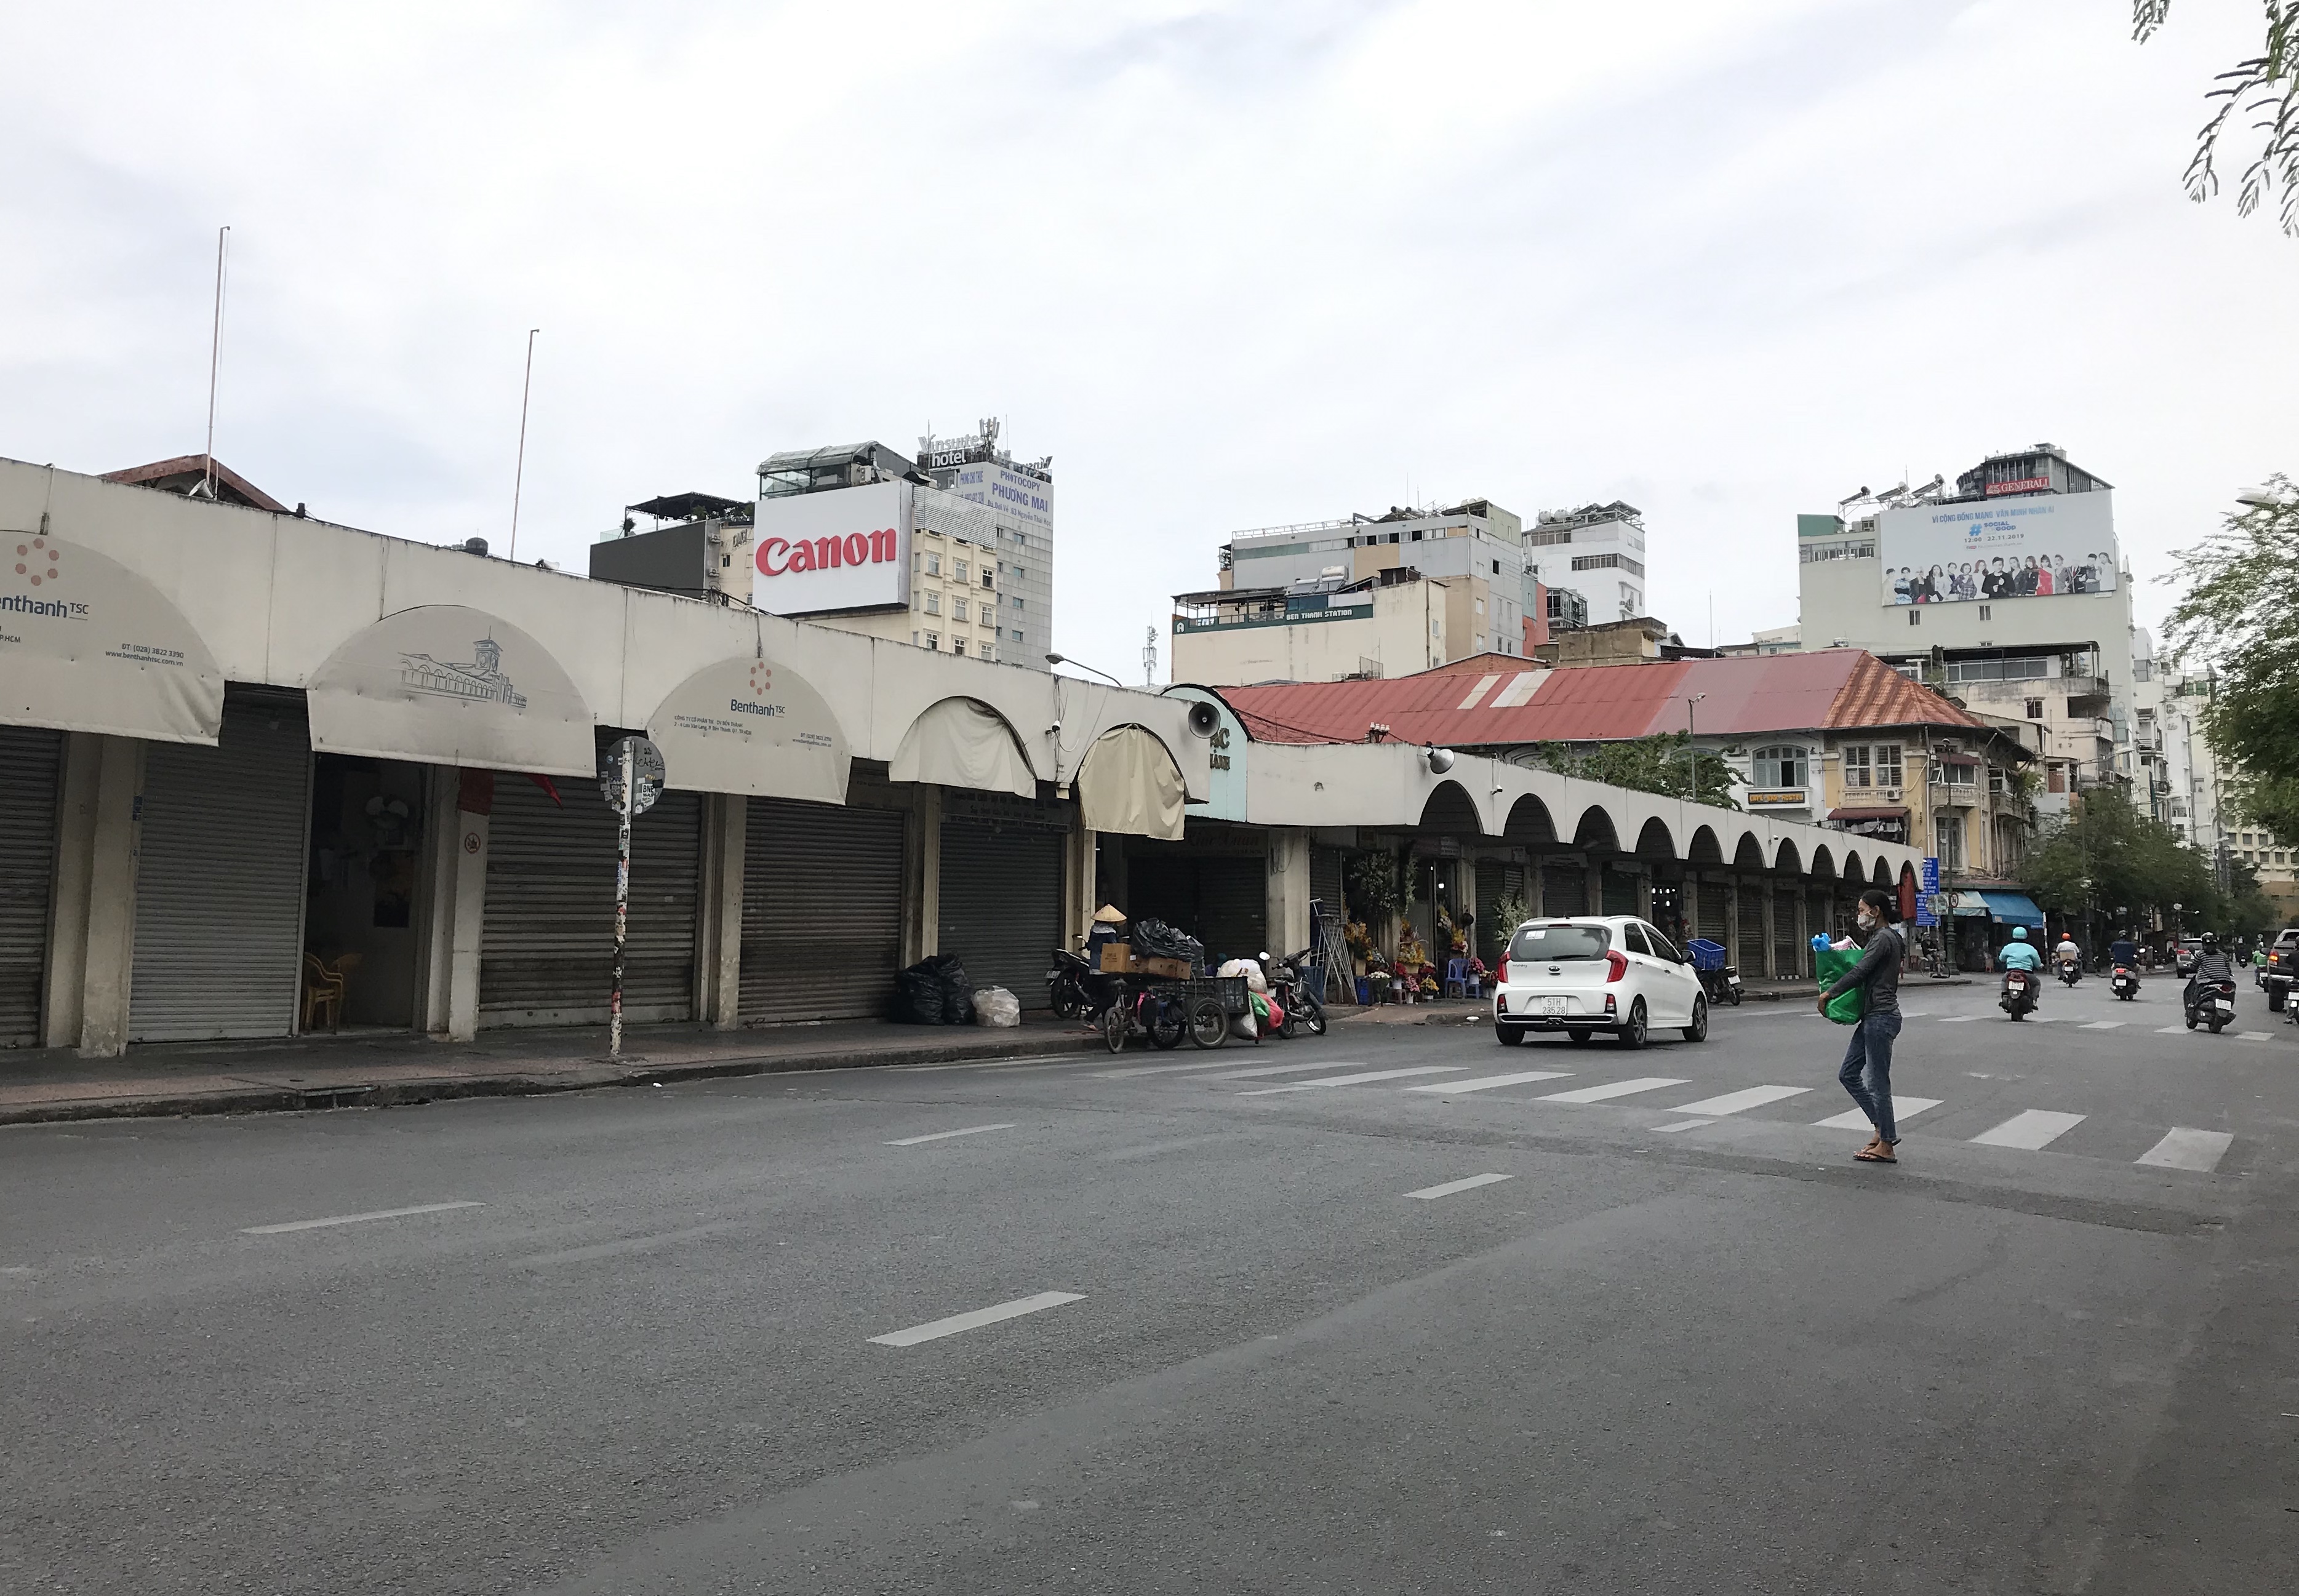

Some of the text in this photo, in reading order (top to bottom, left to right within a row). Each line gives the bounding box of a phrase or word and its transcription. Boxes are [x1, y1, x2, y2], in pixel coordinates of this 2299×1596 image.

[932, 449, 966, 468] hotel
[1001, 469, 1041, 492] PHOTOCOPY
[2001, 477, 2047, 492] GENERALI
[991, 482, 1029, 506] PHƯƠNG
[1031, 495, 1048, 513] MAI
[1940, 513, 1956, 524] CỘNG
[1987, 533, 2025, 541] 22.11.2019
[756, 527, 897, 577] Canon
[0, 594, 89, 618] nthanh TSC
[1301, 611, 1322, 620] THANH
[1324, 608, 1352, 618] STATION
[1177, 621, 1185, 632] A
[105, 650, 183, 666] www.benthanhtsc.com.vn
[730, 699, 785, 717] Benthanh TSC
[1547, 998, 1561, 1007] 51H
